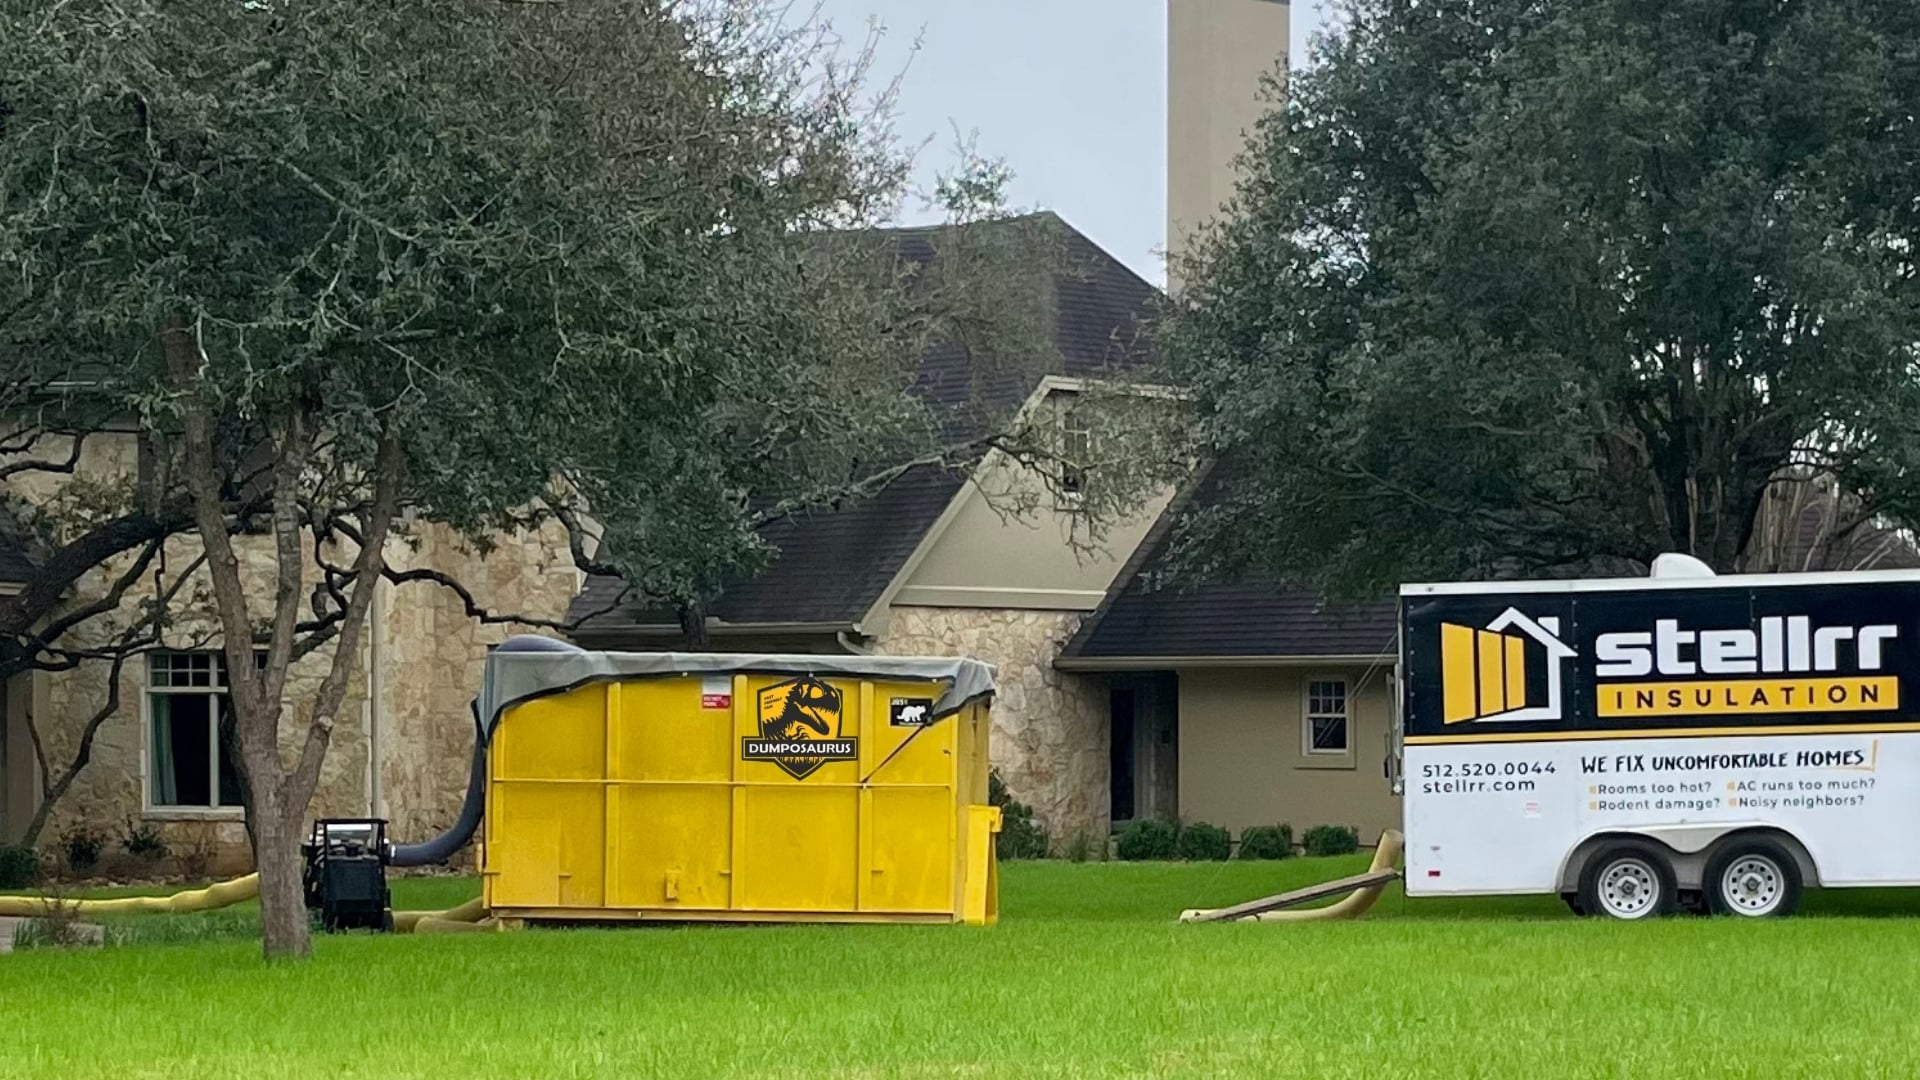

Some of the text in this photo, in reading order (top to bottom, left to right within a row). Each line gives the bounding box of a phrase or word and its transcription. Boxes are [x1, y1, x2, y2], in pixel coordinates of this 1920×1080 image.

[1596, 615, 1898, 676] stellrr
[1616, 684, 1879, 709] INSULATION
[749, 743, 851, 753] DUMPOSAURUS
[1581, 749, 1865, 773] WE FIX UNCOMFORTABLE HOMES
[1423, 761, 1556, 778] 512.520.0044
[1423, 779, 1535, 793] stellrr.com
[1598, 781, 1712, 795] Rooms too hot?
[1736, 778, 1876, 791] AC runs too much?
[1599, 798, 1720, 812] Rodent damage?
[1739, 795, 1865, 809] Noisy neighbors?
